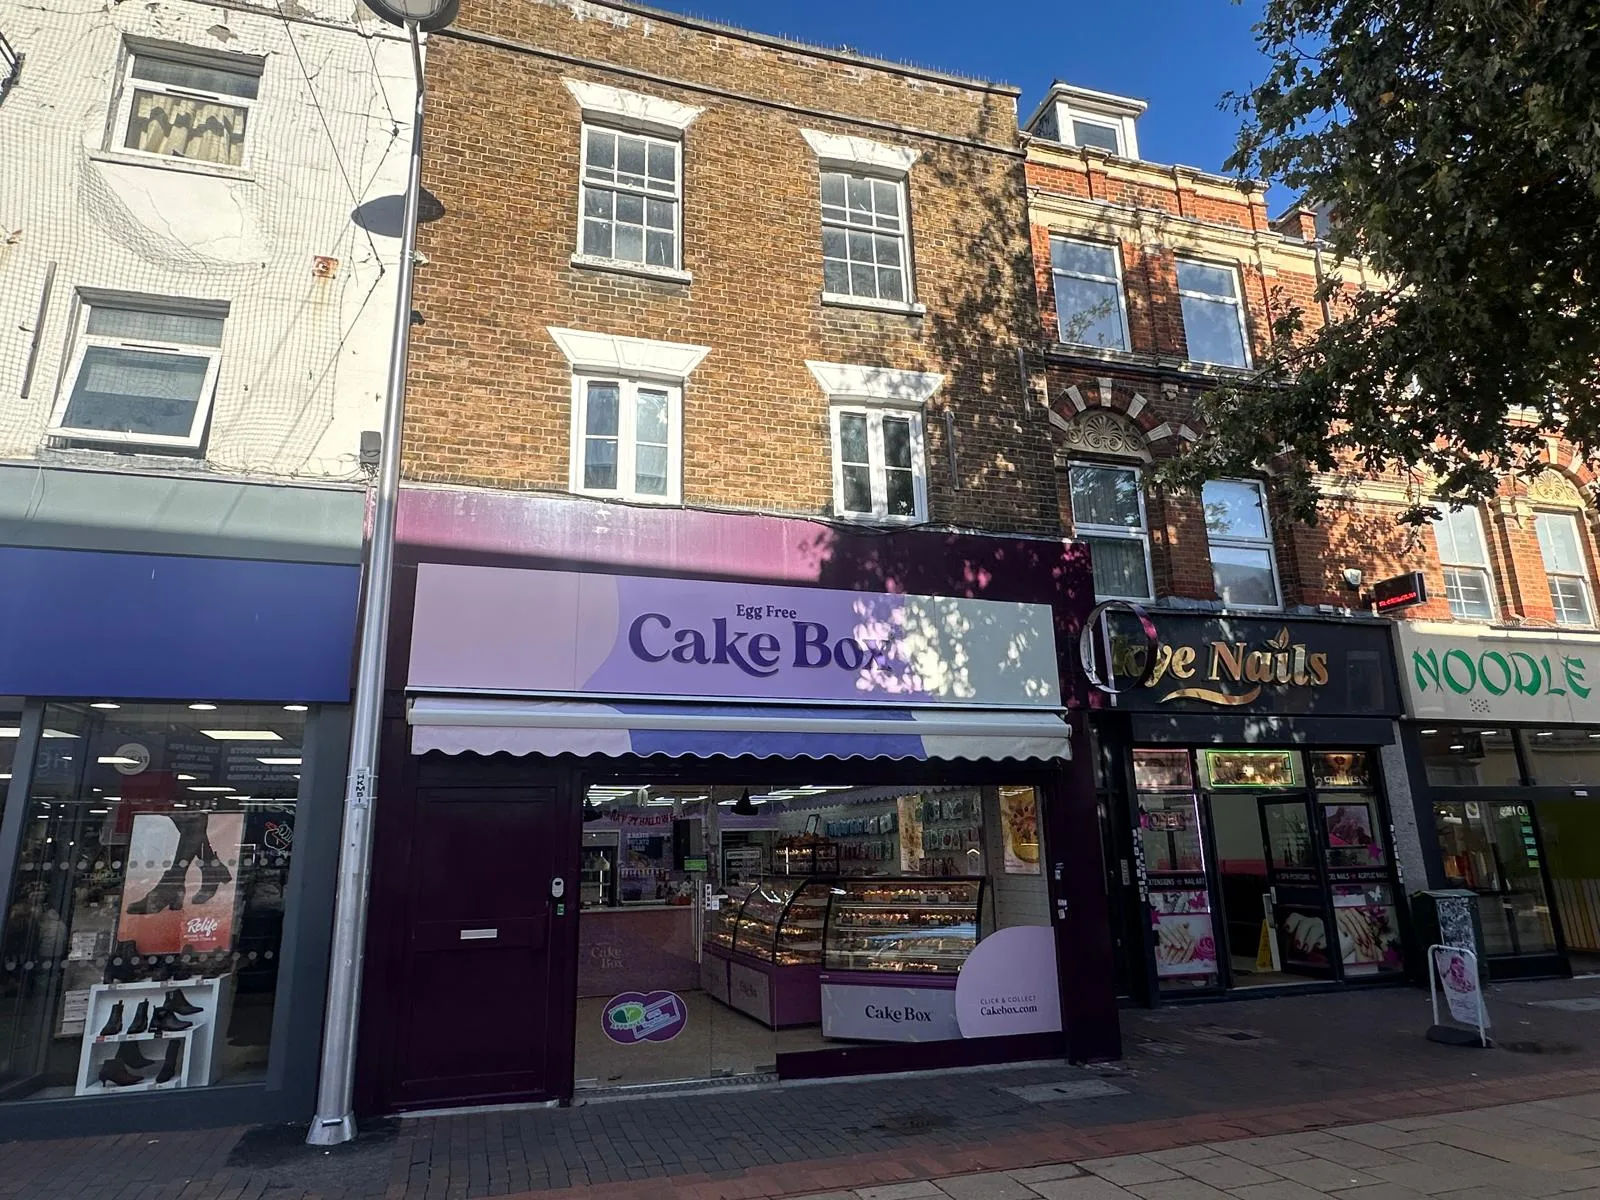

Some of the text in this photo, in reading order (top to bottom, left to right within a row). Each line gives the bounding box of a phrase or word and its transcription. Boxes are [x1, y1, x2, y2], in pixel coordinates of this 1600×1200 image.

[736, 603, 797, 620] Egg Free
[628, 612, 893, 678] Cake Box
[1207, 641, 1329, 686] Nails
[1412, 647, 1592, 699] NOODLE
[187, 917, 218, 937] Relife
[865, 1005, 931, 1023] Cake Box
[980, 1005, 1038, 1016] Cakebox.com
